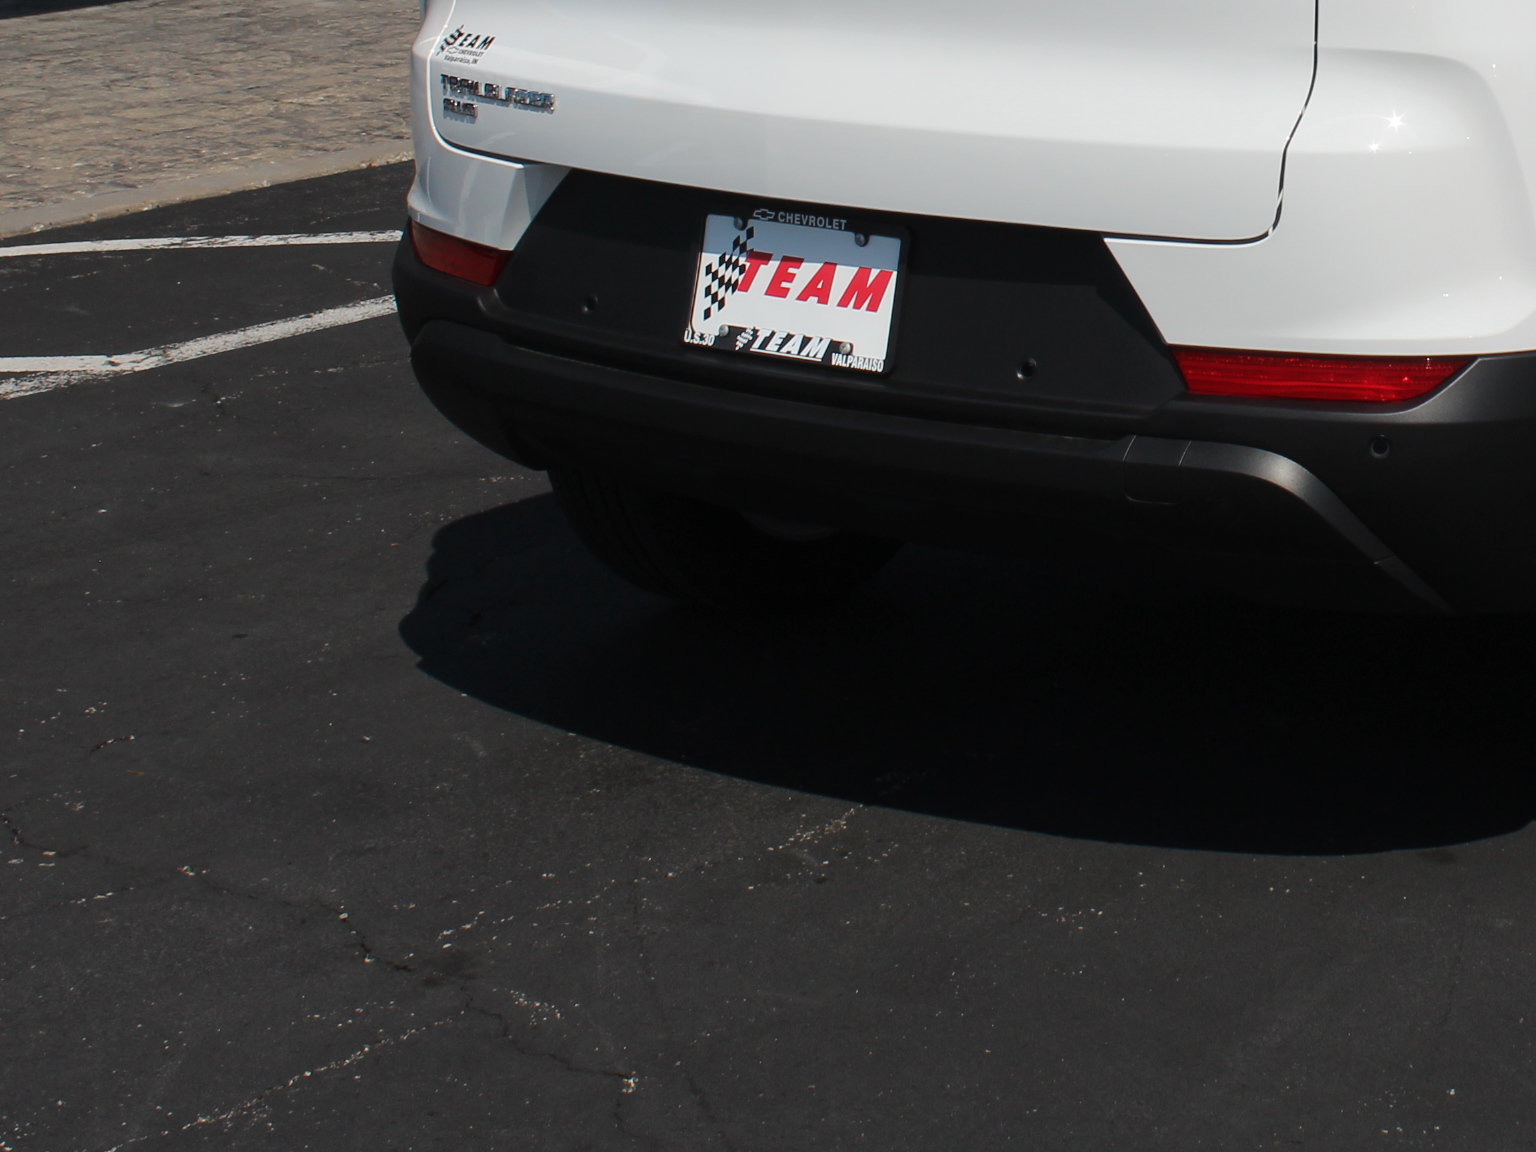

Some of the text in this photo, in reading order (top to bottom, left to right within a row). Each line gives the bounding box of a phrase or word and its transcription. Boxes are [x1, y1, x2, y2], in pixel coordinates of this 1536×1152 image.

[777, 211, 848, 231] CHEVROLET
[737, 250, 894, 313] TEAM
[751, 328, 832, 359] TEAM
[831, 352, 884, 373] VALPARAISO
